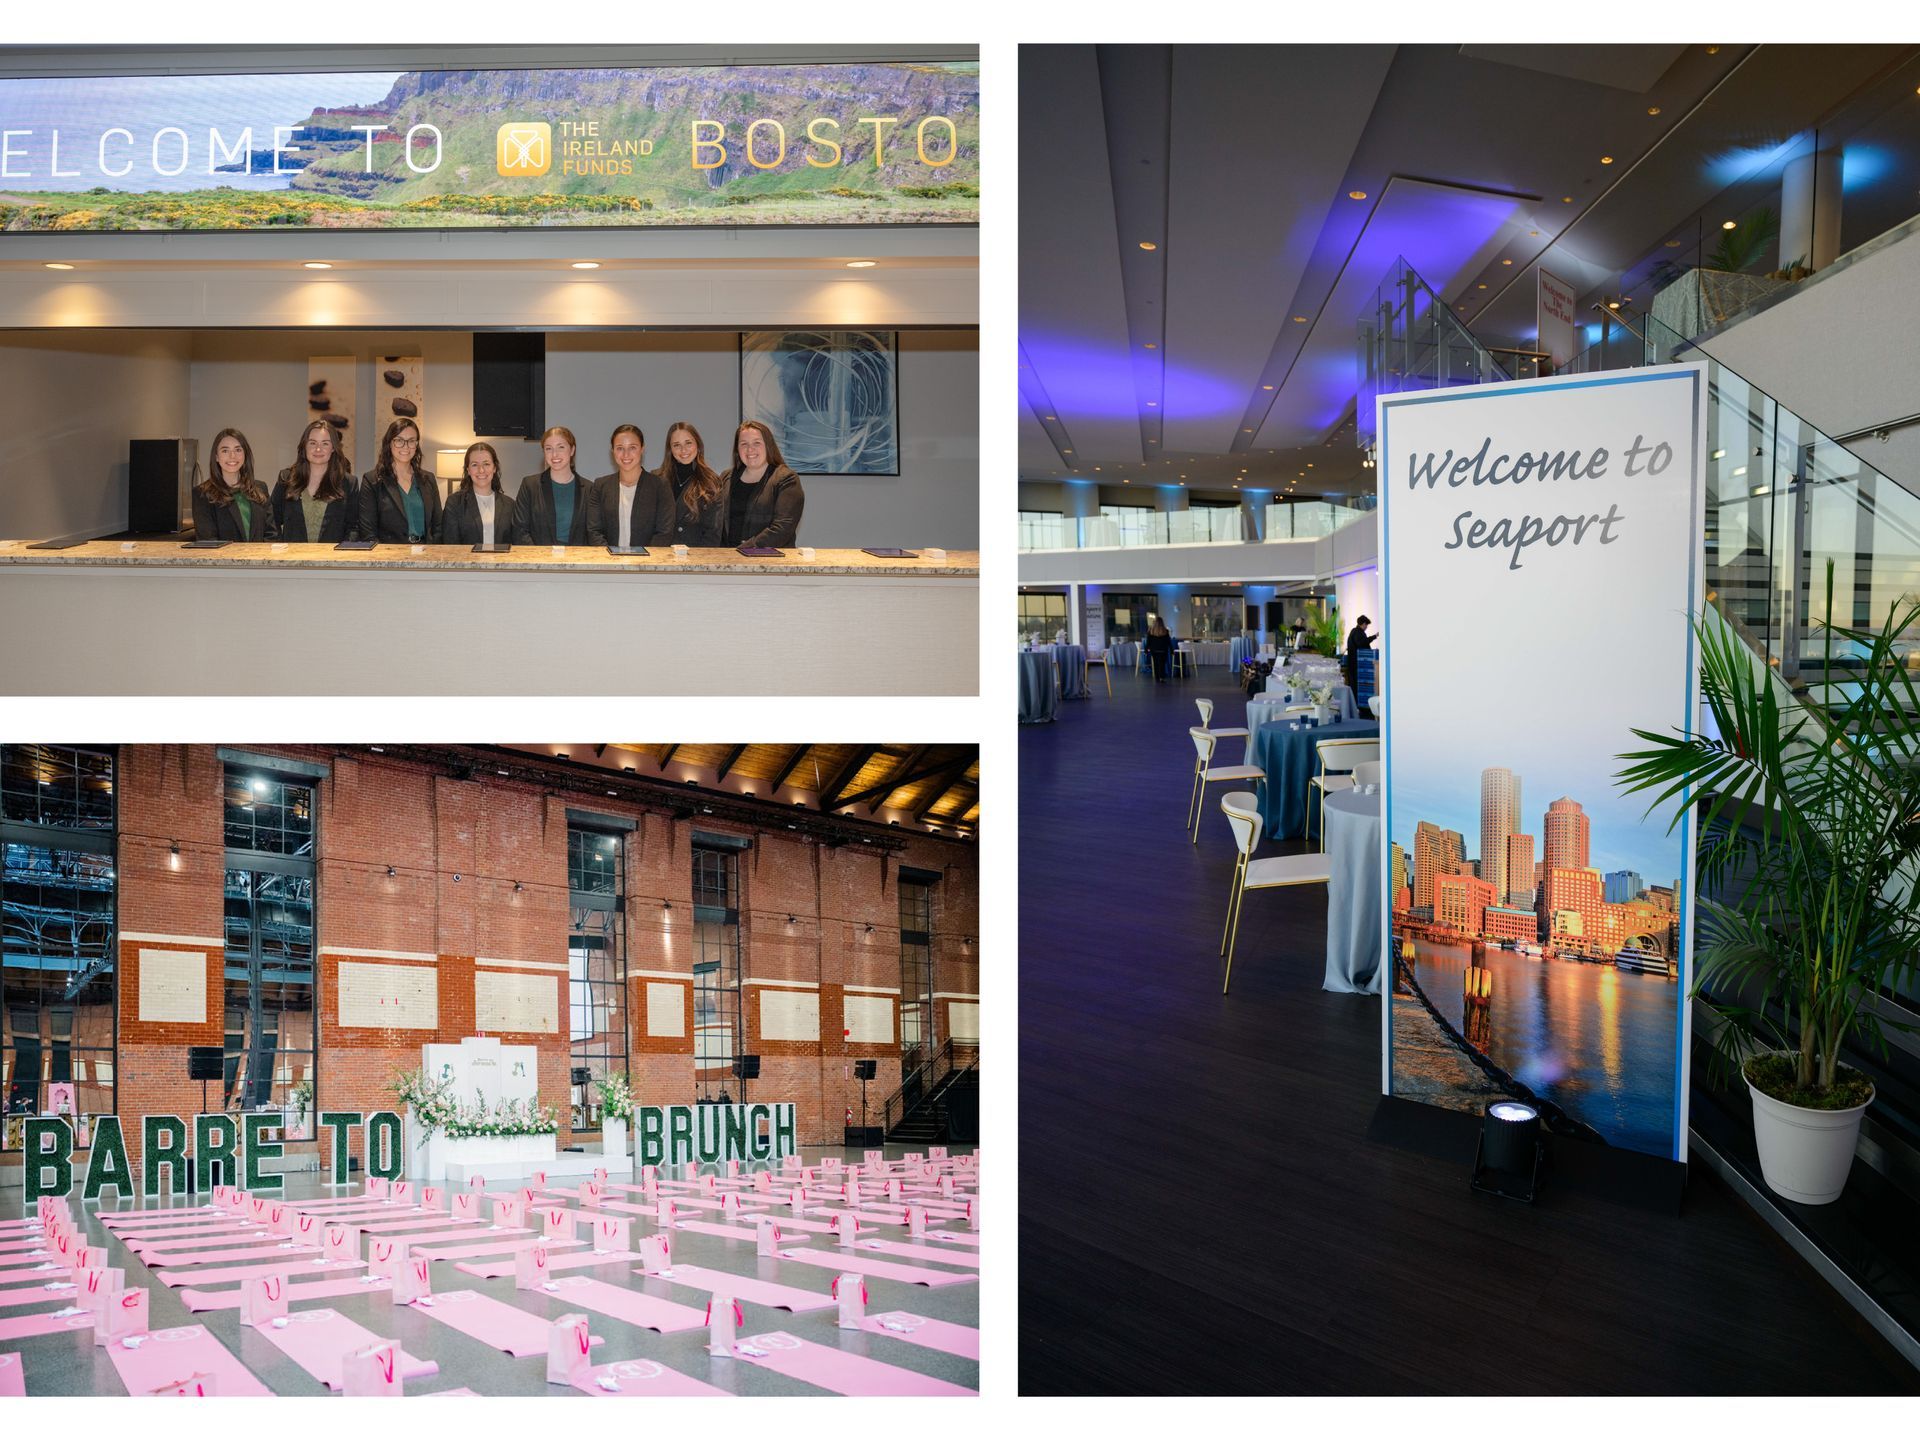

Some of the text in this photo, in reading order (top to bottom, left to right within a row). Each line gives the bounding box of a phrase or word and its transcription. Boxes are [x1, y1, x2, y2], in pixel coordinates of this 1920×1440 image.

[560, 120, 599, 137] THE
[691, 116, 957, 170] BOSTO
[350, 123, 443, 174] TO
[563, 139, 653, 157] IRELAND
[563, 158, 633, 176] FUNDS
[1542, 280, 1566, 302] Welcome
[1543, 301, 1571, 324] North End
[1408, 434, 1673, 490] Welcome to
[1444, 503, 1625, 570] Seaport
[23, 1103, 796, 1204] BARRE TO BRUNCH
